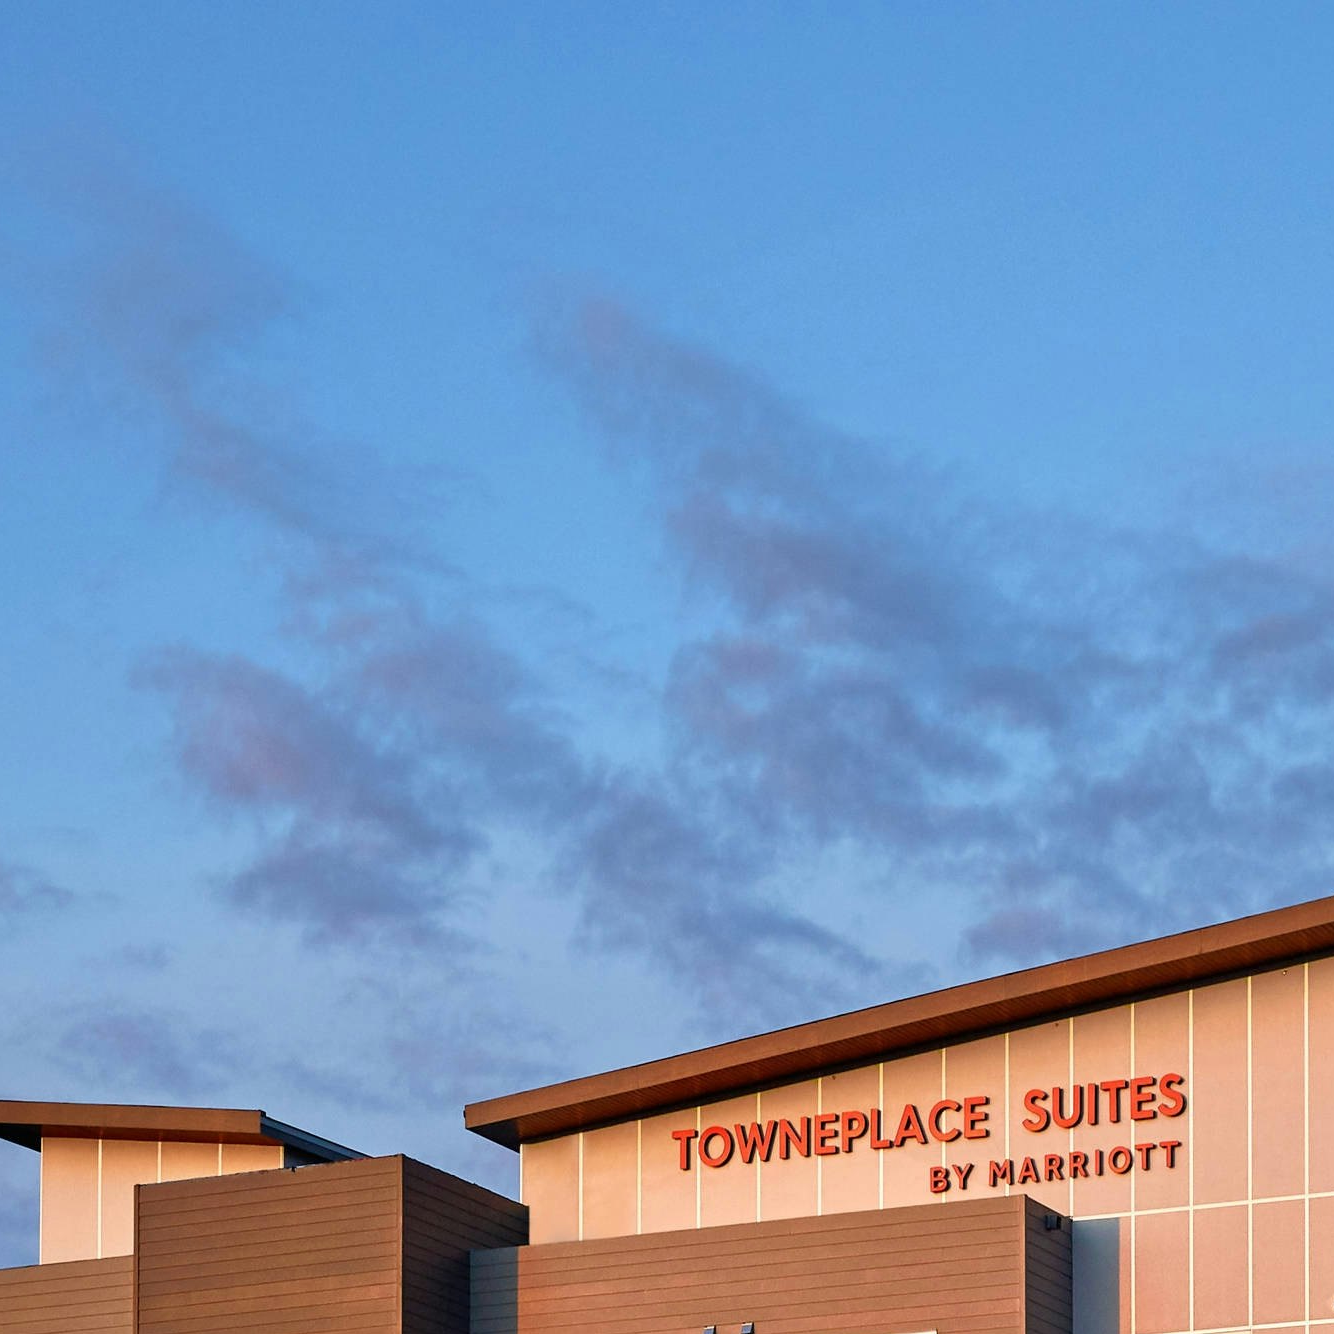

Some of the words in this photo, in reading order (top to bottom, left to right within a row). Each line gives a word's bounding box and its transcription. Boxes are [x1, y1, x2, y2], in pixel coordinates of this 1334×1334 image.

[672, 1096, 990, 1170] TOWNEPLACE
[1022, 1073, 1186, 1132] SUITES
[930, 1164, 974, 1193] BY
[989, 1141, 1181, 1187] MARRIOTT
